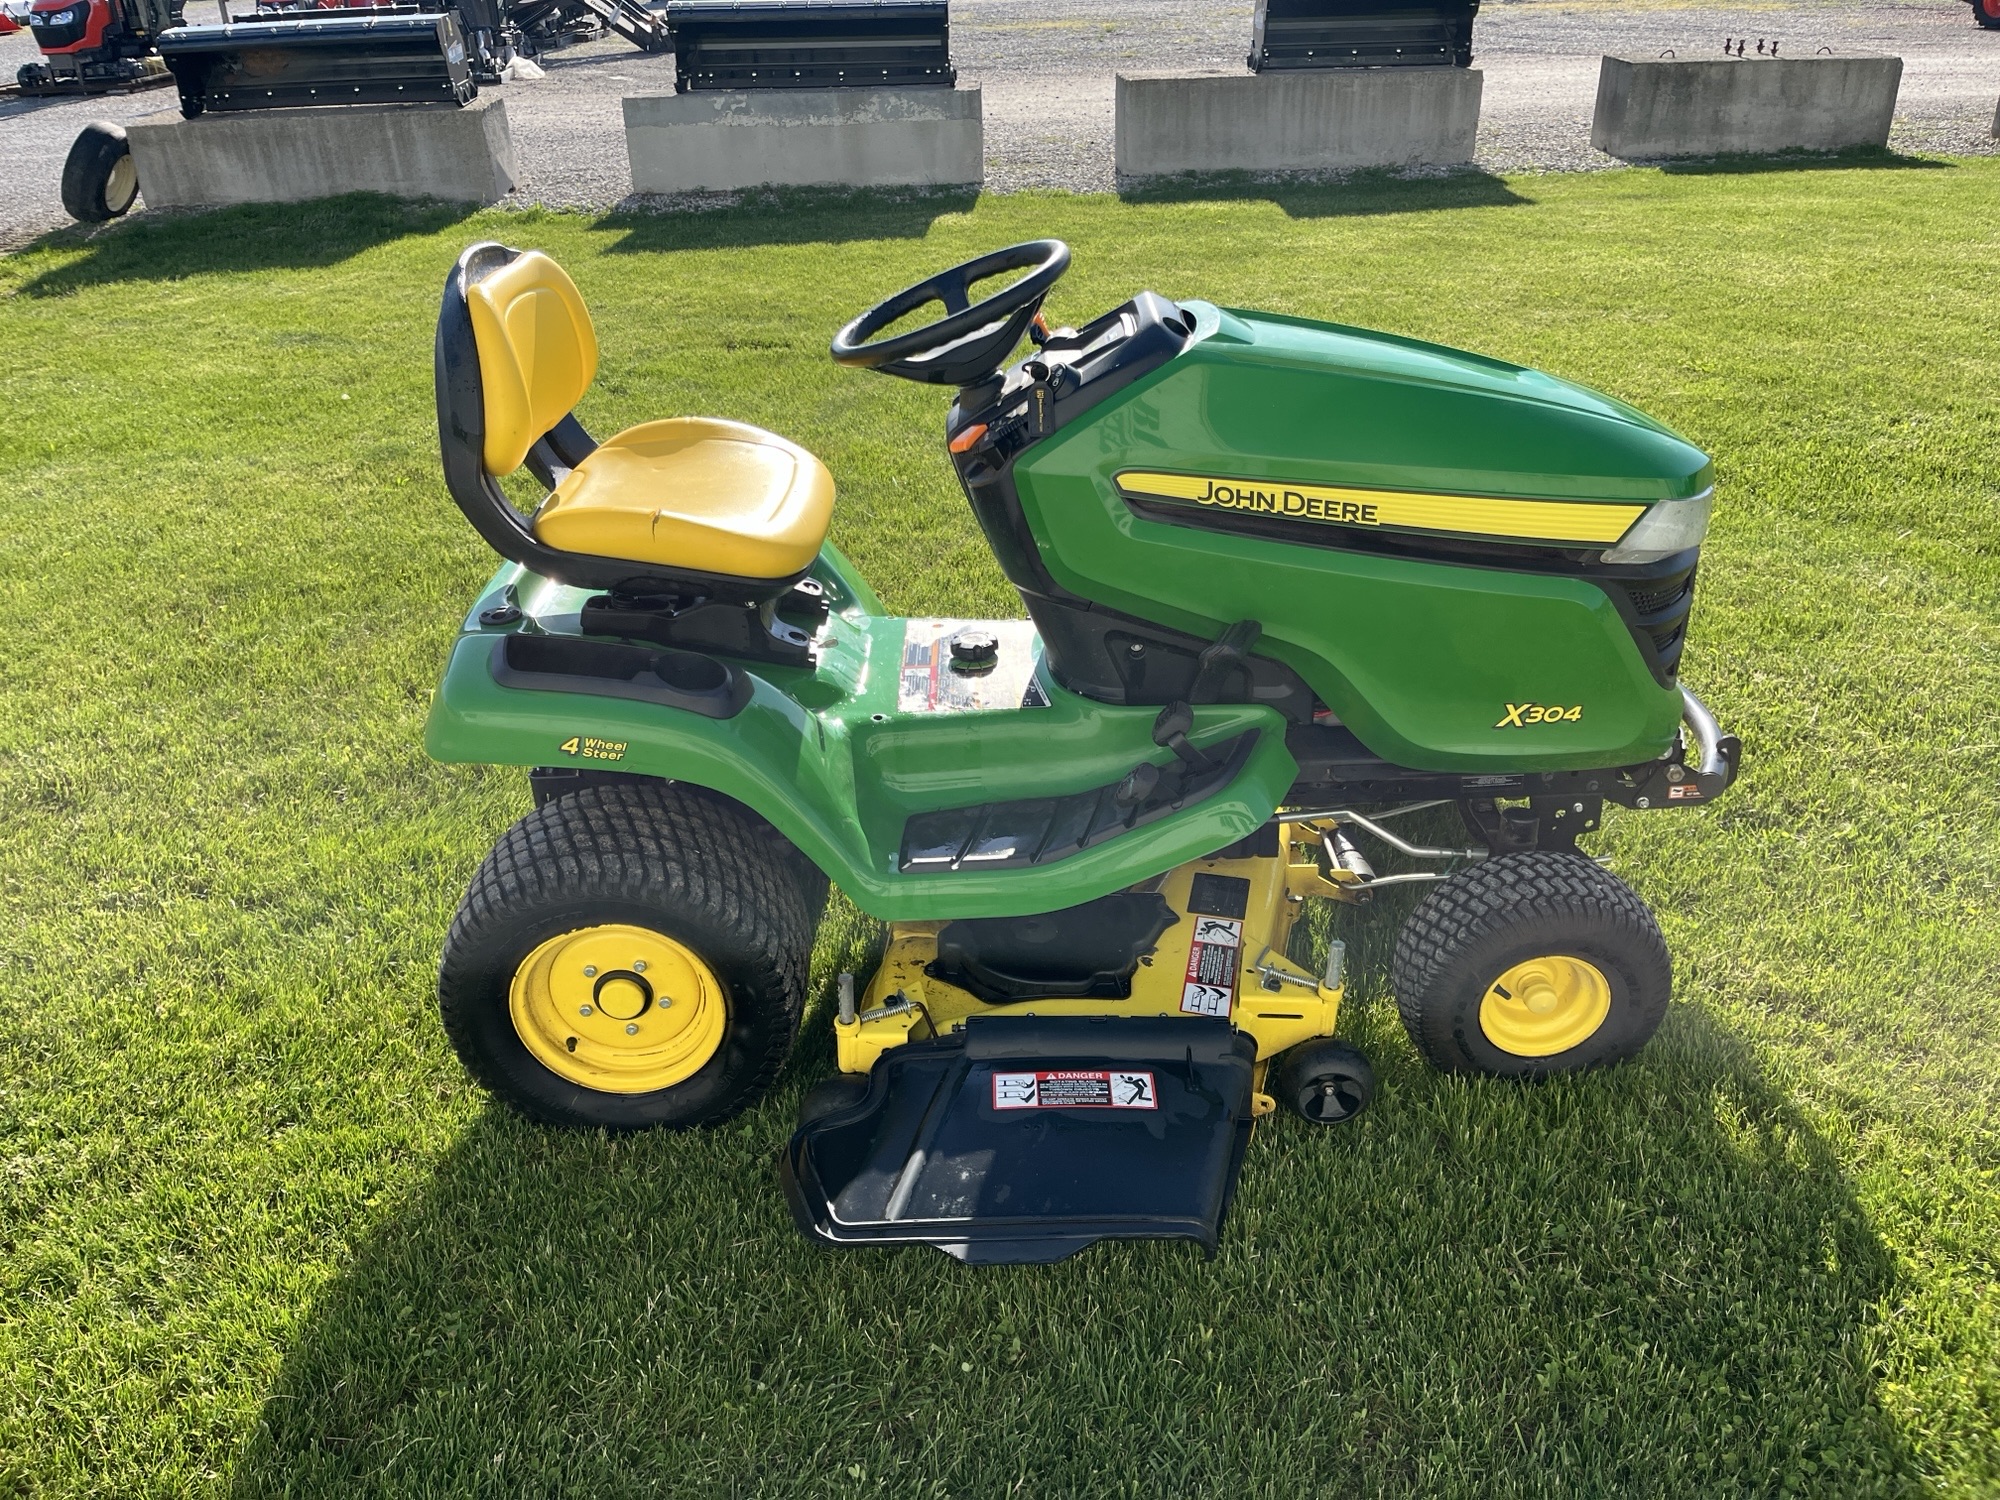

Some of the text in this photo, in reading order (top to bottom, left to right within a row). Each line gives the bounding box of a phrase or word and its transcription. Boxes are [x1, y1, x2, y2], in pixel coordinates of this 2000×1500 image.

[1197, 481, 1378, 523] JOHN DEERE
[1493, 702, 1583, 727] X304
[560, 737, 628, 755] 4 Wheel
[582, 747, 624, 761] Steer
[1190, 947, 1200, 971] DANGER
